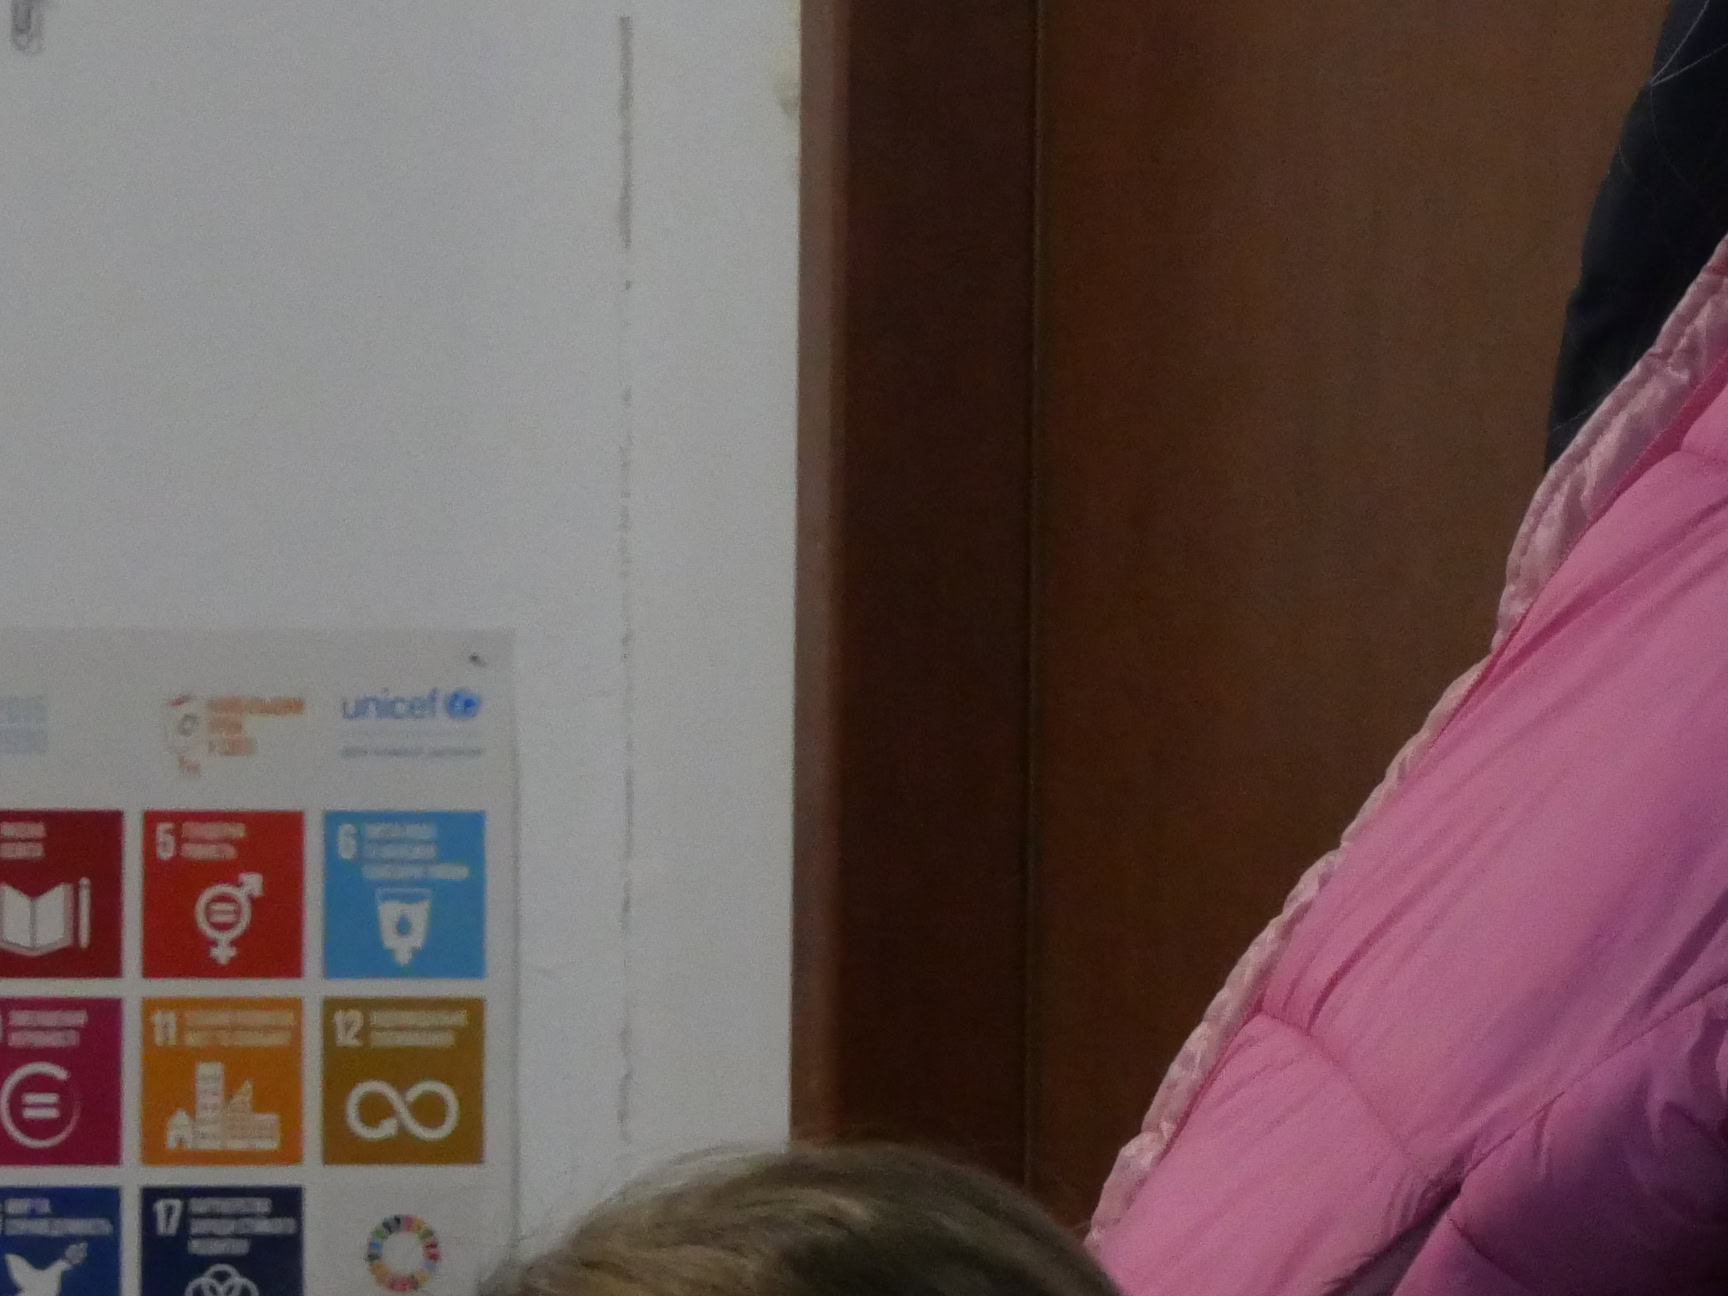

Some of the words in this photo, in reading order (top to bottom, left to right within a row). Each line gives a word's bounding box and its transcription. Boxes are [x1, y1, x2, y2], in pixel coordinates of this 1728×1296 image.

[342, 687, 439, 720] unicef
[154, 820, 176, 861] 5
[336, 822, 358, 860] 6
[152, 1008, 177, 1047] 11
[332, 1008, 364, 1047] 12
[152, 1198, 183, 1237] 17
